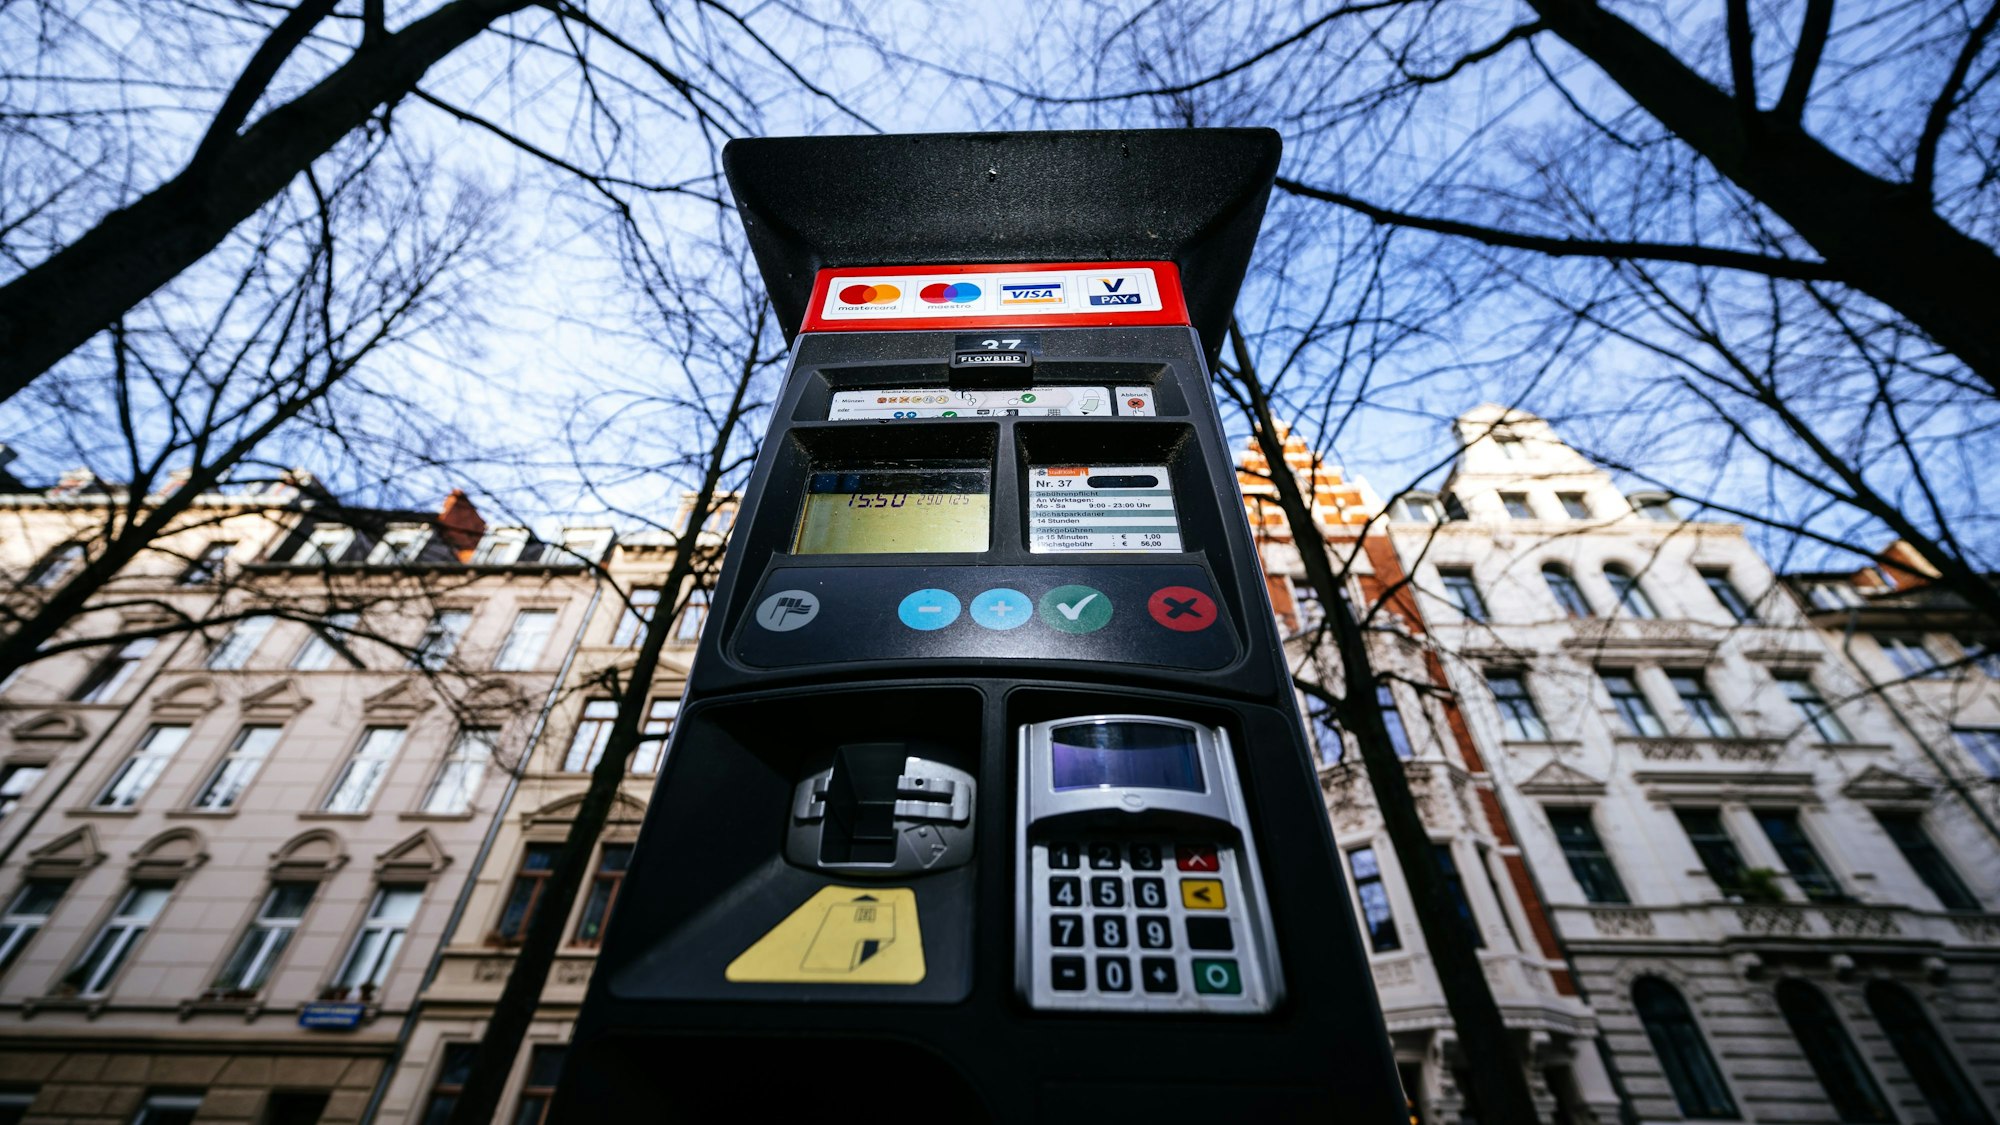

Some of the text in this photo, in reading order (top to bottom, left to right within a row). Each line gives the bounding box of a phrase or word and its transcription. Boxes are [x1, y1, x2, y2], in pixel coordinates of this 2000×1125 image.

[1096, 278, 1124, 292] V
[1012, 290, 1054, 298] VISA
[1101, 296, 1130, 304] PAY
[848, 493, 907, 508] 15:50
[1057, 883, 1160, 905] 4 5 6
[1059, 920, 1164, 947] 7 8 9
[1106, 962, 1124, 989] 0
